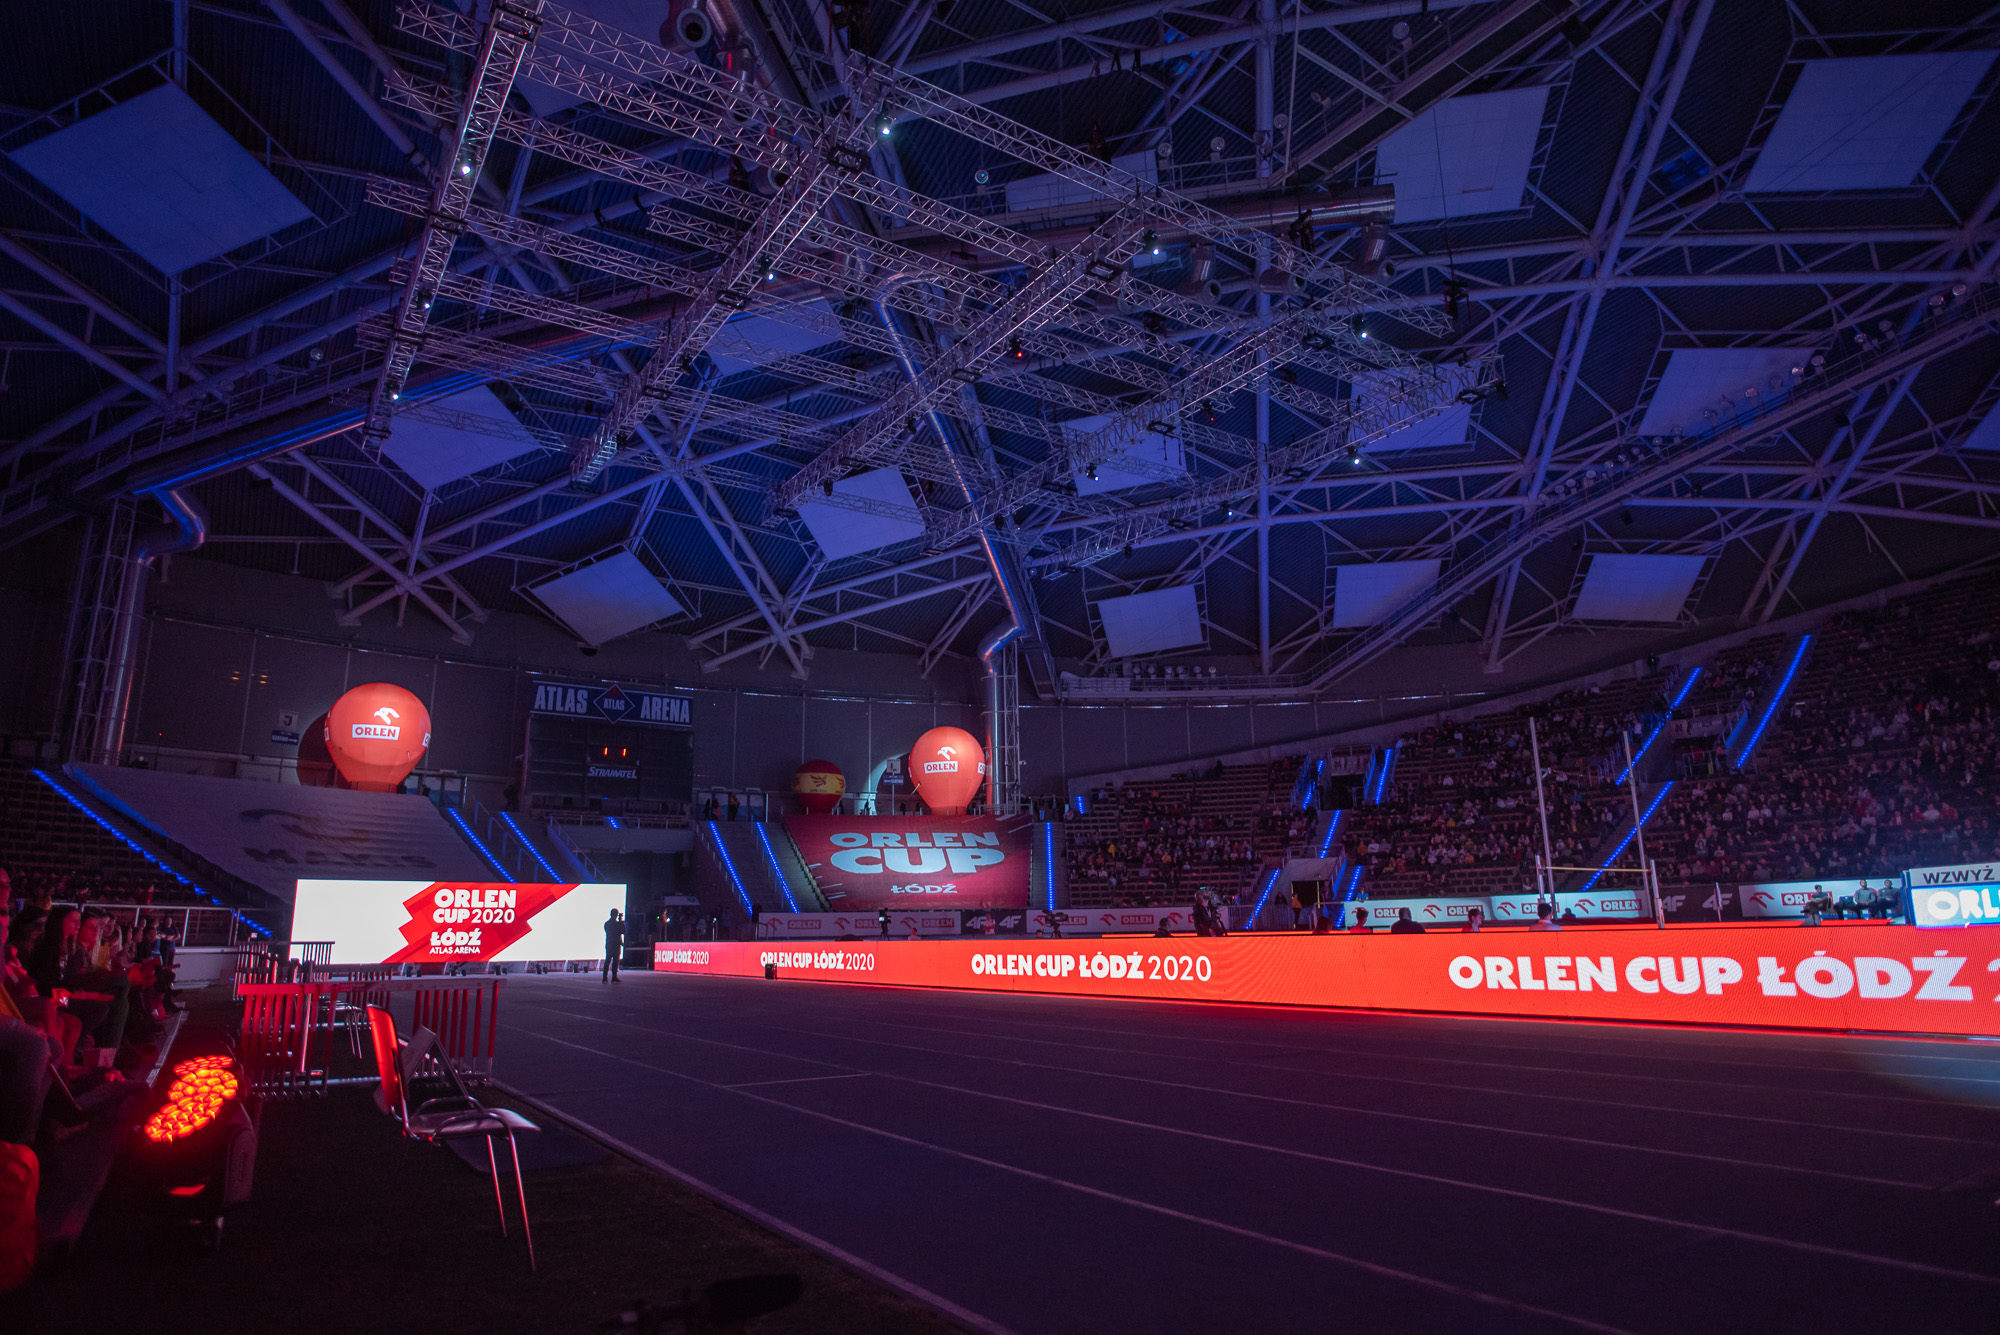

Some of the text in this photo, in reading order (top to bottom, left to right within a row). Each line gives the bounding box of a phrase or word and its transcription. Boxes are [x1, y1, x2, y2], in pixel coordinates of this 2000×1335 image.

[534, 685, 690, 723] ATLAS ARENA
[603, 698, 625, 711] ATLAS
[355, 726, 396, 738] ORLEN
[926, 763, 956, 771] ORLEN
[830, 832, 1000, 847] ORLEN
[830, 848, 1005, 874] CUP
[1922, 865, 1995, 884] WZWYŻ
[891, 884, 957, 894] ŁÓDŹ
[434, 888, 517, 908] ORLEN
[1783, 893, 1808, 905] ORL
[1927, 888, 2000, 920] ORL
[1376, 908, 1400, 917] ORLE
[1602, 901, 1639, 910] ORLEN
[432, 908, 515, 924] CUP 2020
[999, 914, 1022, 928] 4F
[1123, 916, 1153, 924] ORLEN
[856, 920, 879, 928] ORLE
[923, 919, 954, 928] ORLEN
[430, 927, 482, 946] ŁÓDŹ
[430, 946, 481, 954] ATLAS ARENA
[662, 950, 673, 962] CUP
[692, 951, 709, 964] 2020
[760, 950, 875, 970] ORLEN CUP ŁÓDŹ 2020
[971, 951, 1212, 981] ORLEN CUP ŁÓDŹ 2020
[1448, 955, 1617, 992] ORLEN
[1625, 955, 1743, 995] CUP
[1757, 950, 1974, 1001] ŁÓDŹ
